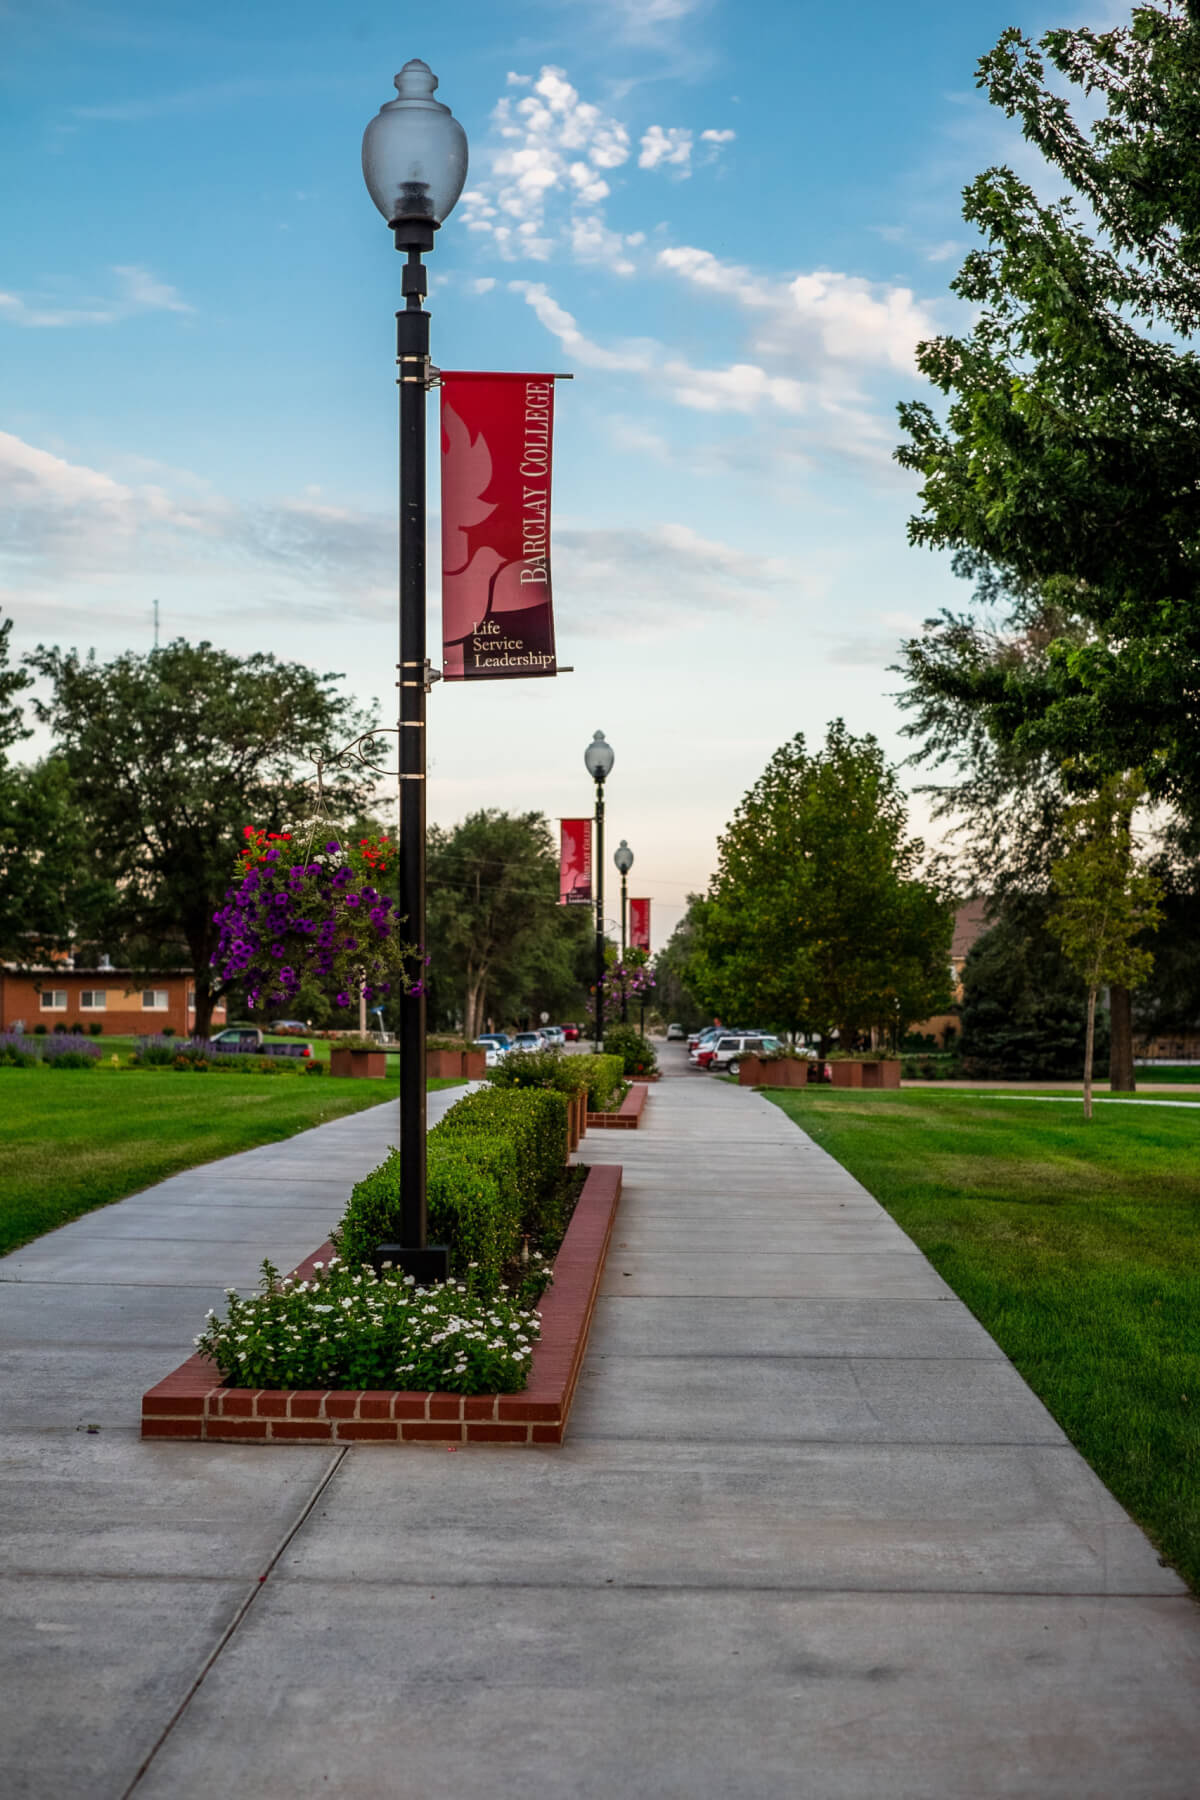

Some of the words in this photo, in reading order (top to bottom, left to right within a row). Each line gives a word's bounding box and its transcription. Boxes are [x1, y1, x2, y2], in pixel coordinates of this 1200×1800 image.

[519, 382, 550, 477] COLLEGE
[520, 486, 548, 585] BARCLAY
[473, 621, 501, 635] Life
[473, 637, 524, 651] Service
[474, 651, 552, 668] Leadership
